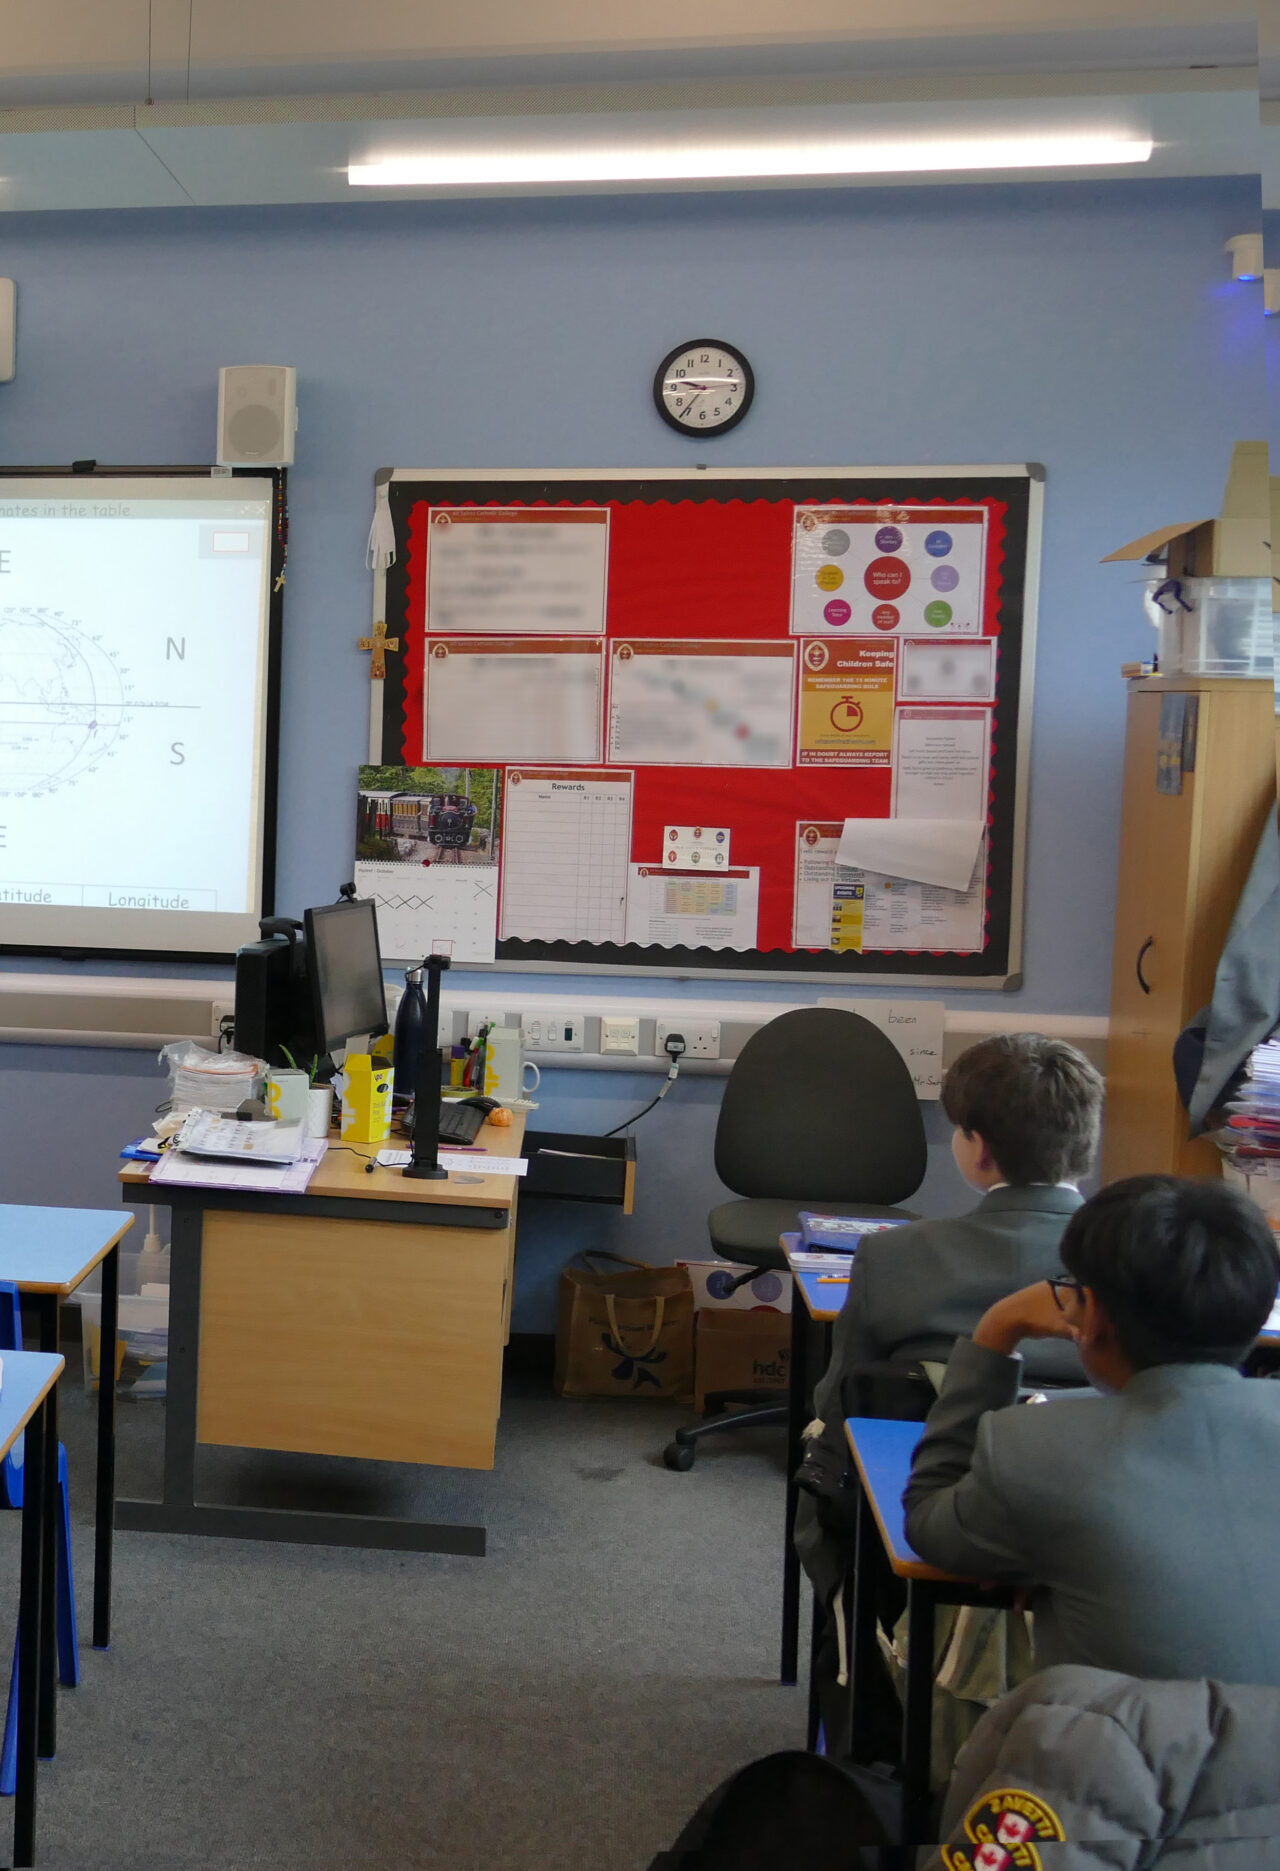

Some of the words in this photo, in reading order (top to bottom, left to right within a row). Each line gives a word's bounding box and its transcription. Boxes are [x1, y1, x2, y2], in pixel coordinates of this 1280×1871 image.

[700, 355, 709, 363] 12
[687, 360, 693, 368] 11
[675, 370, 685, 378] 10
[727, 369, 733, 377] 2
[670, 384, 676, 392] 9
[730, 384, 737, 392] 3
[676, 399, 682, 407] 8
[725, 398, 732, 406] 4
[699, 412, 705, 420] 6
[713, 408, 720, 416] 5
[42, 504, 56, 518] in
[61, 503, 87, 518] the
[166, 636, 186, 661] N
[859, 650, 895, 659] Keeping
[836, 660, 873, 668] Children
[874, 660, 894, 668] Safe
[170, 742, 185, 765] S
[824, 757, 870, 765] SAFEGUARDING
[551, 782, 585, 791] Rewards
[108, 892, 190, 910] Longitude
[888, 1008, 917, 1024] been
[910, 1048, 937, 1056] since
[753, 1359, 786, 1376] hdc
